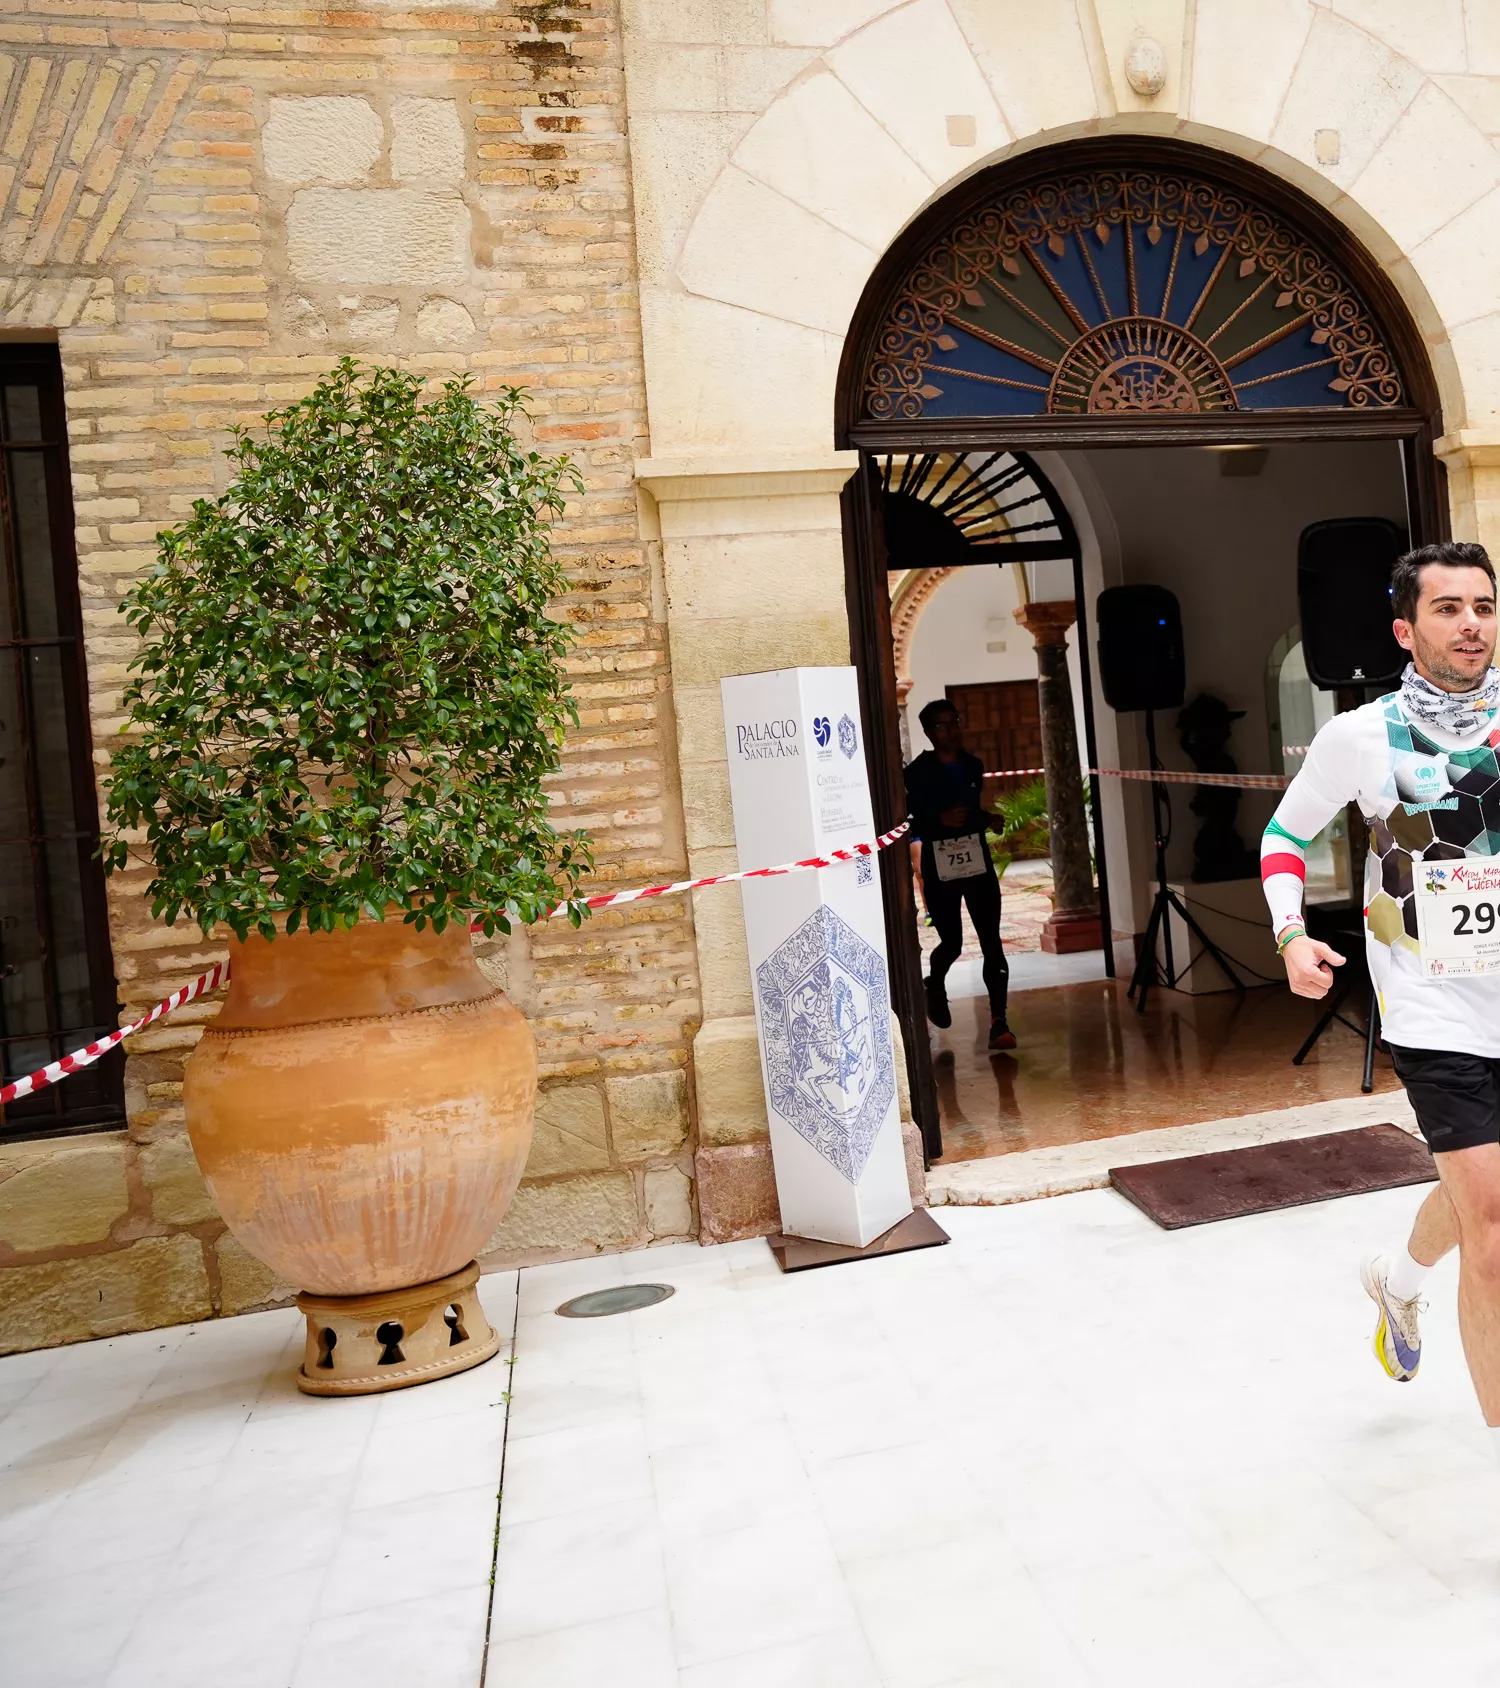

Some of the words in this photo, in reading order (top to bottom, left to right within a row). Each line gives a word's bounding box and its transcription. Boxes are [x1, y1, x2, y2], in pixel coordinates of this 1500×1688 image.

[736, 719, 796, 754] PALACIO
[744, 742, 774, 761] SANTA
[776, 740, 799, 758] ANA
[1404, 797, 1459, 816] DEPORTEMANIA
[948, 852, 972, 866] 751
